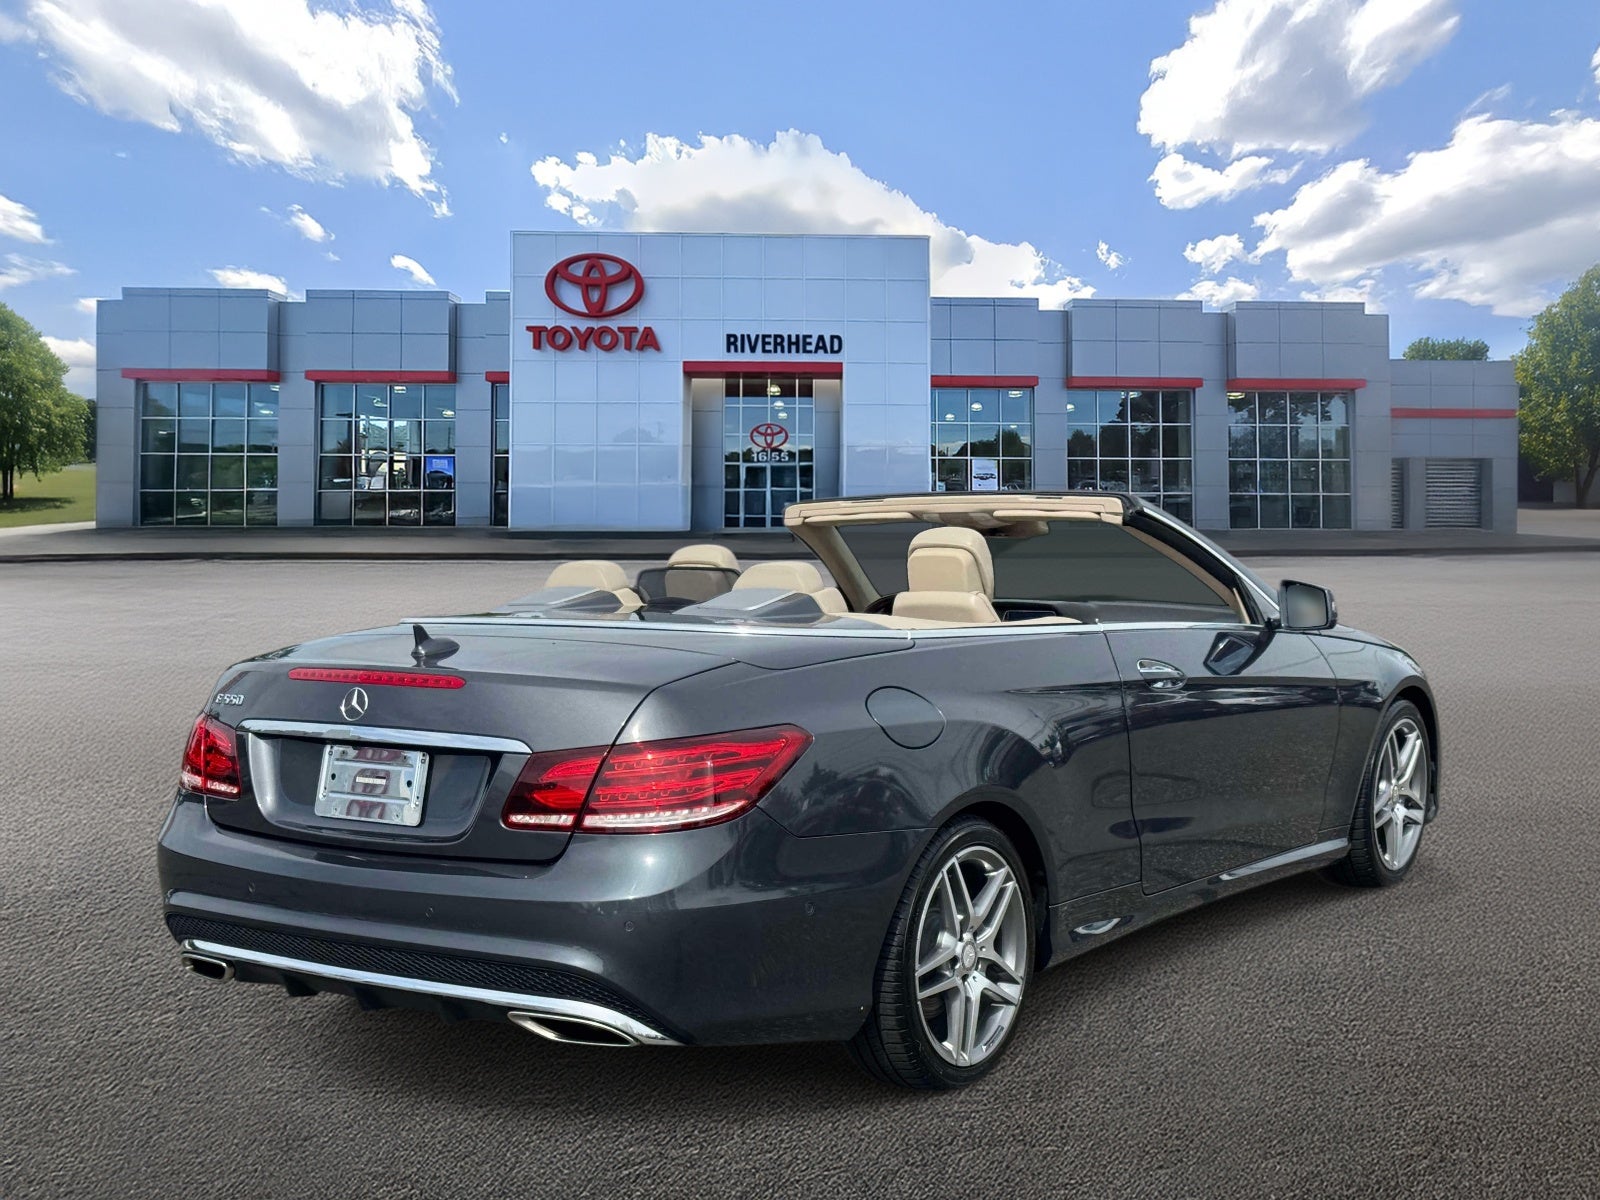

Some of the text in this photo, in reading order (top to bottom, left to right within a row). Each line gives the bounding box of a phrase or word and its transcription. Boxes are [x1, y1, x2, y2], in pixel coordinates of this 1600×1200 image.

[526, 326, 660, 352] TOYOTA
[726, 334, 843, 354] RIVERHEAD
[752, 452, 789, 462] 1655
